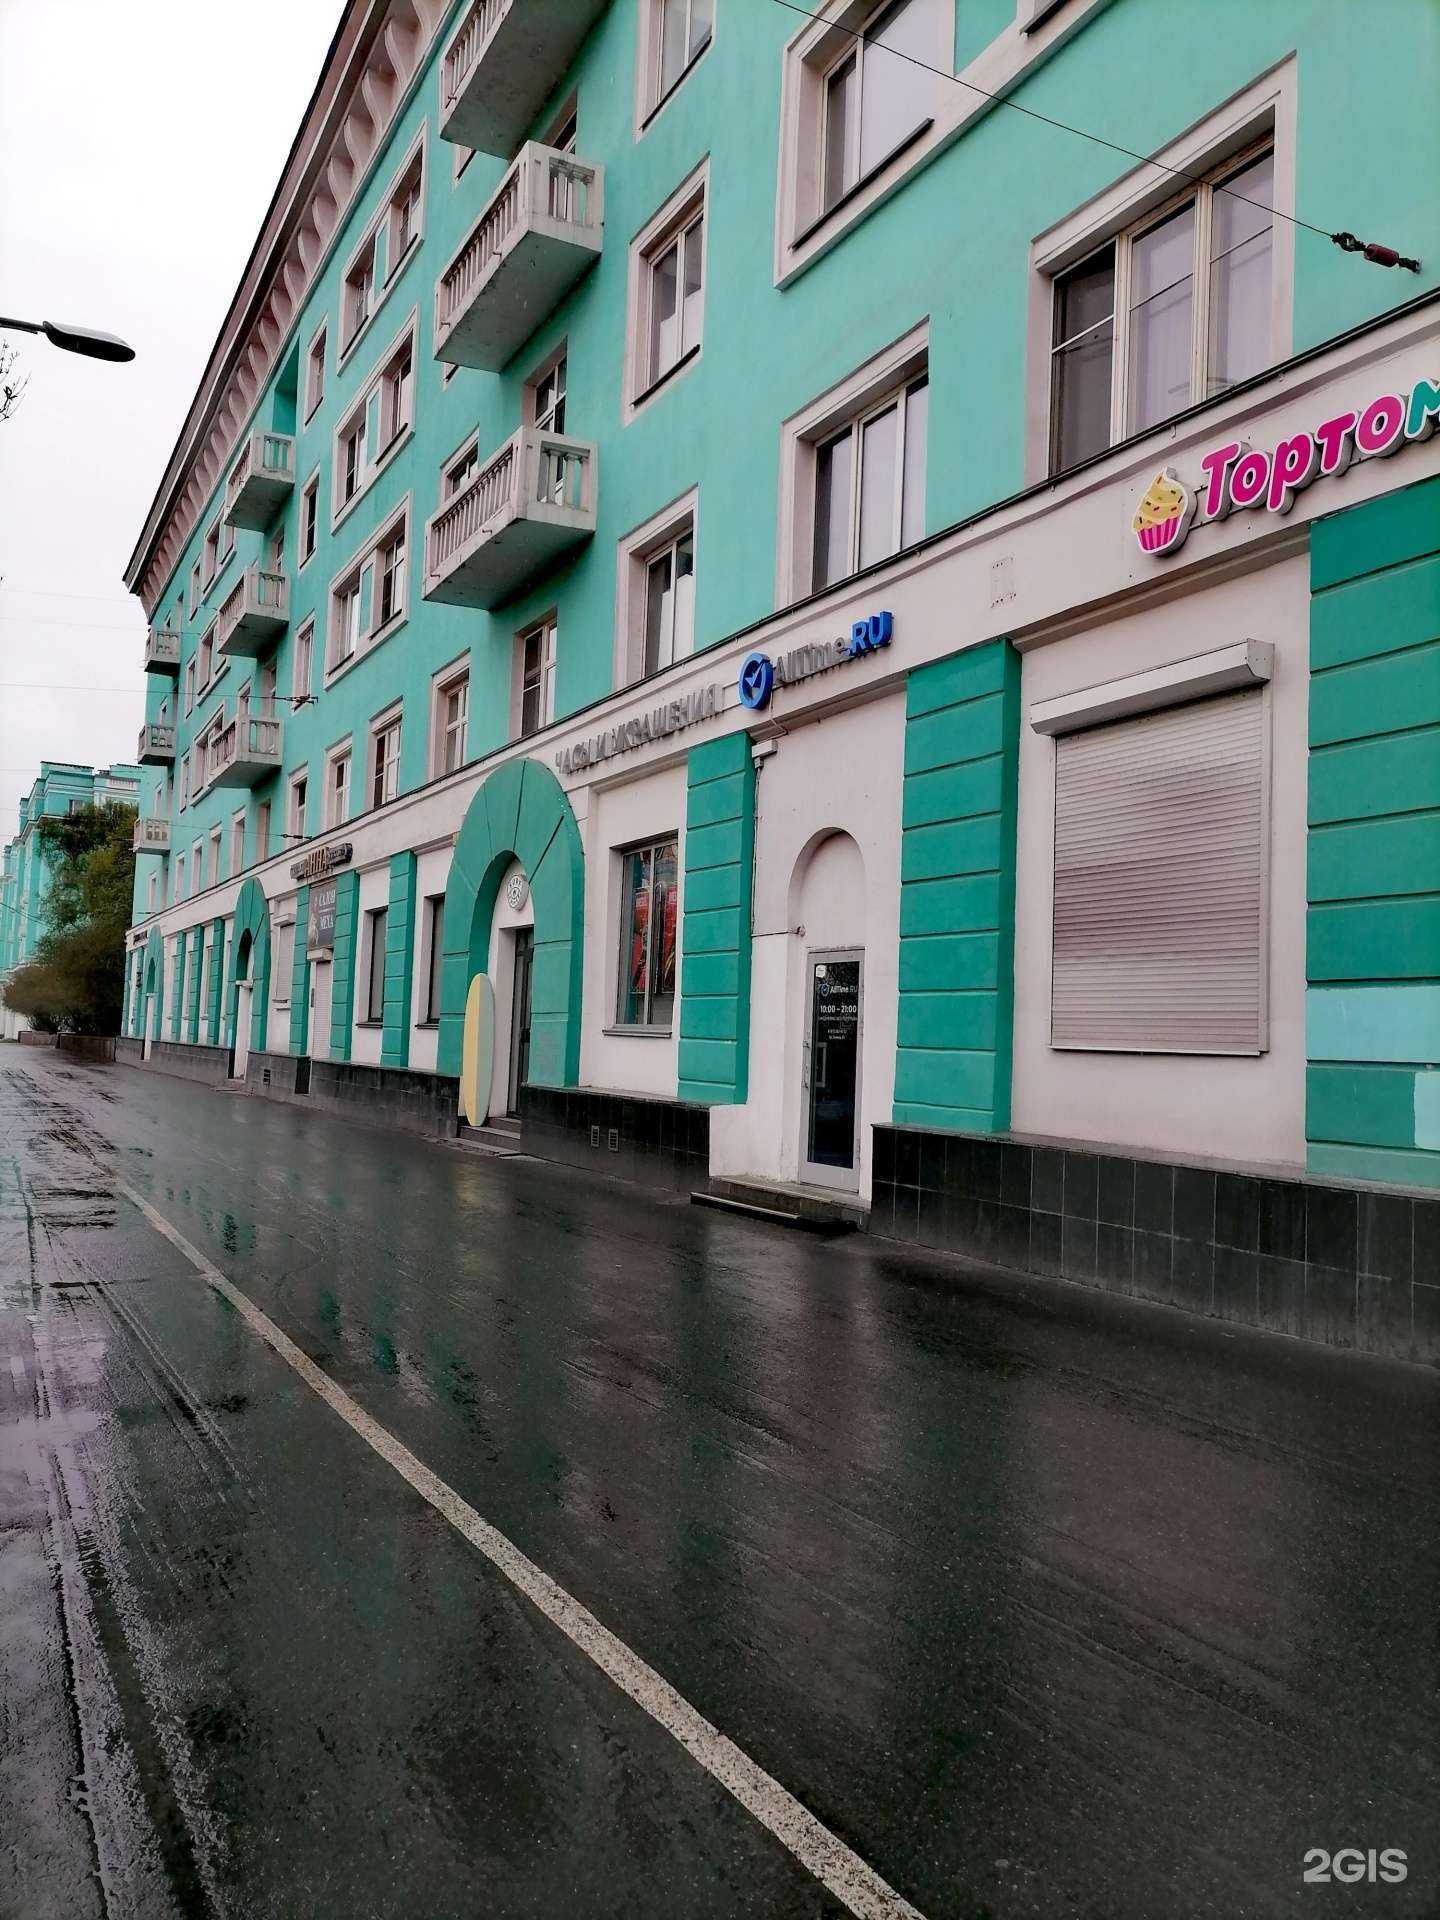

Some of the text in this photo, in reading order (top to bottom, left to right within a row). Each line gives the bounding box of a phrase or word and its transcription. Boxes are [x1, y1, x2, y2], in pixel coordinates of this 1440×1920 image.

[556, 738, 597, 775] ЧАСЫ
[612, 683, 723, 753] УКРАШЕНИЯ
[820, 1005, 836, 1013] 10:00
